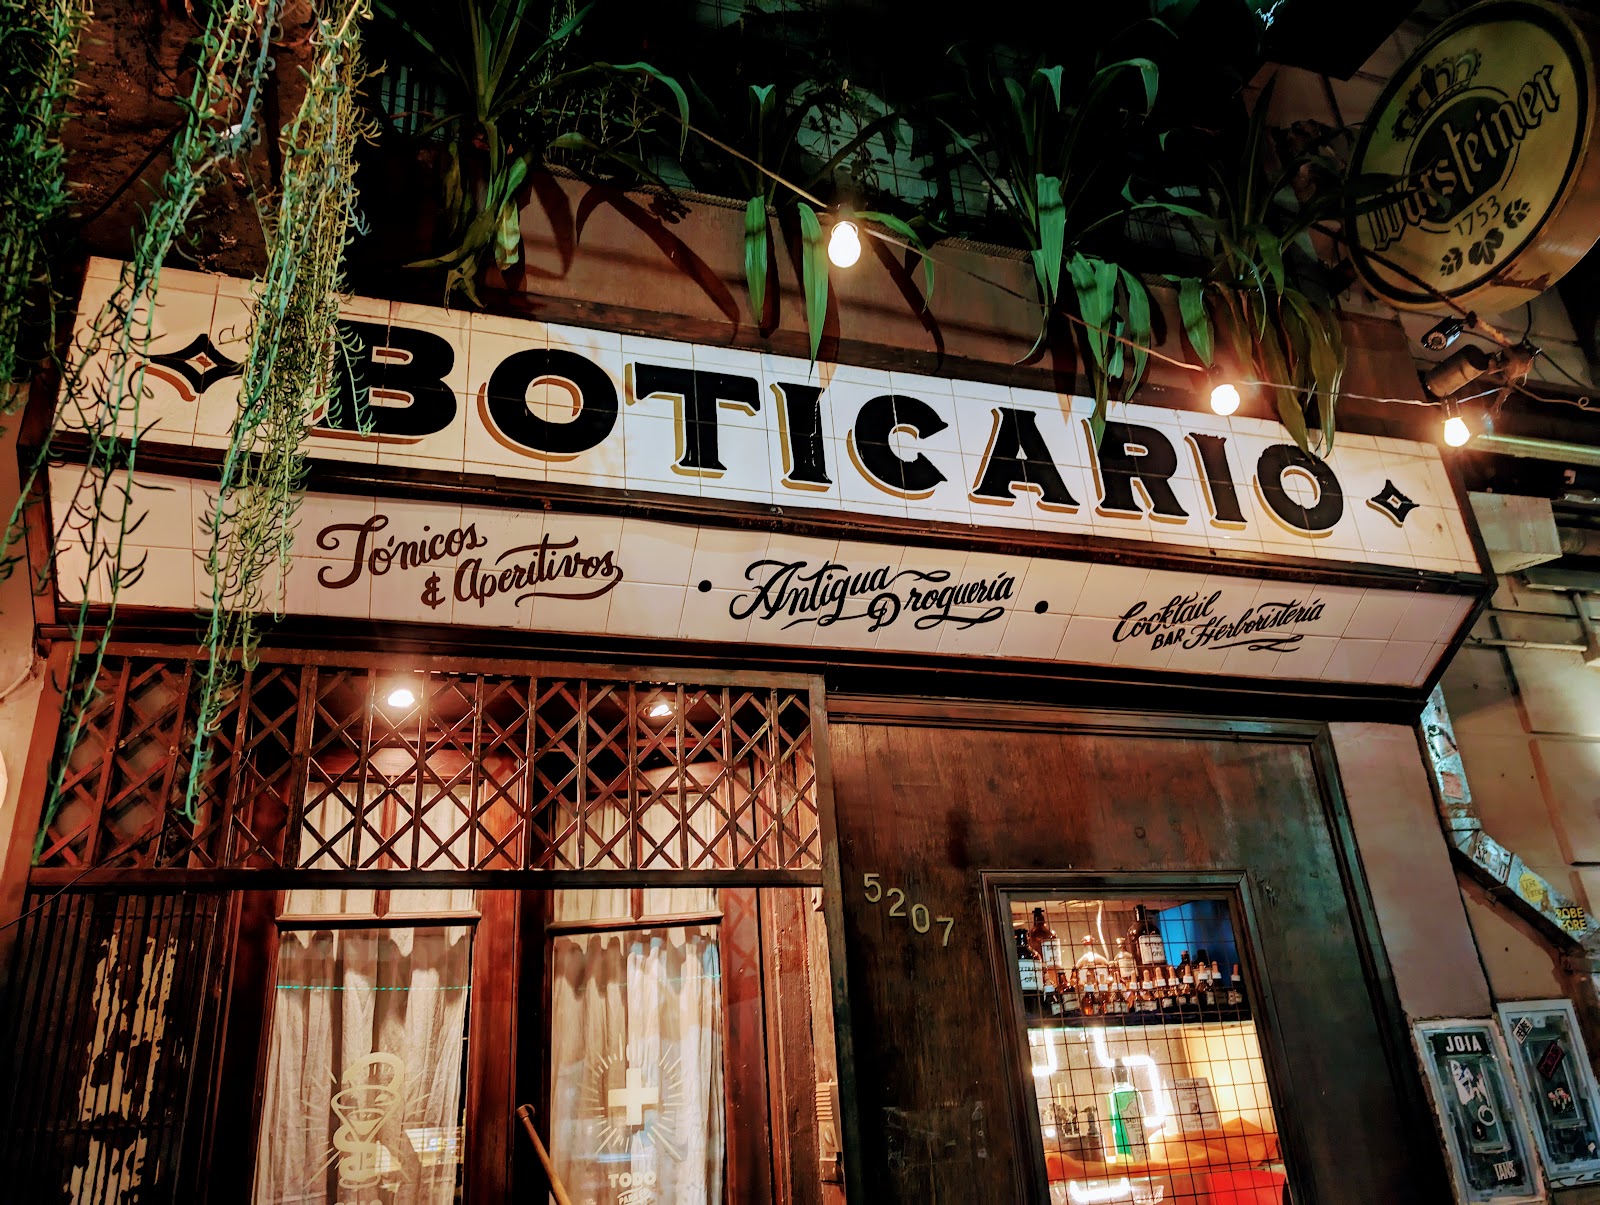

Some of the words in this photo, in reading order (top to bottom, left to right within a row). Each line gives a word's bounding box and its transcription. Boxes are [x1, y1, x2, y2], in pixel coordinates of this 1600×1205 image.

[1454, 194, 1501, 237] 1753
[314, 320, 1346, 536] BOTICARIO
[316, 514, 488, 589] Tónicos
[453, 533, 624, 608] Aperitivos
[729, 560, 901, 630] Antigua
[867, 571, 1016, 632] Droguería
[1112, 590, 1222, 643] Cocktail
[1151, 627, 1187, 651] BAR
[1182, 598, 1326, 652] Herboristería
[863, 872, 955, 948] 5207
[1445, 1034, 1483, 1053] JOIA
[607, 1170, 657, 1189] TODO
